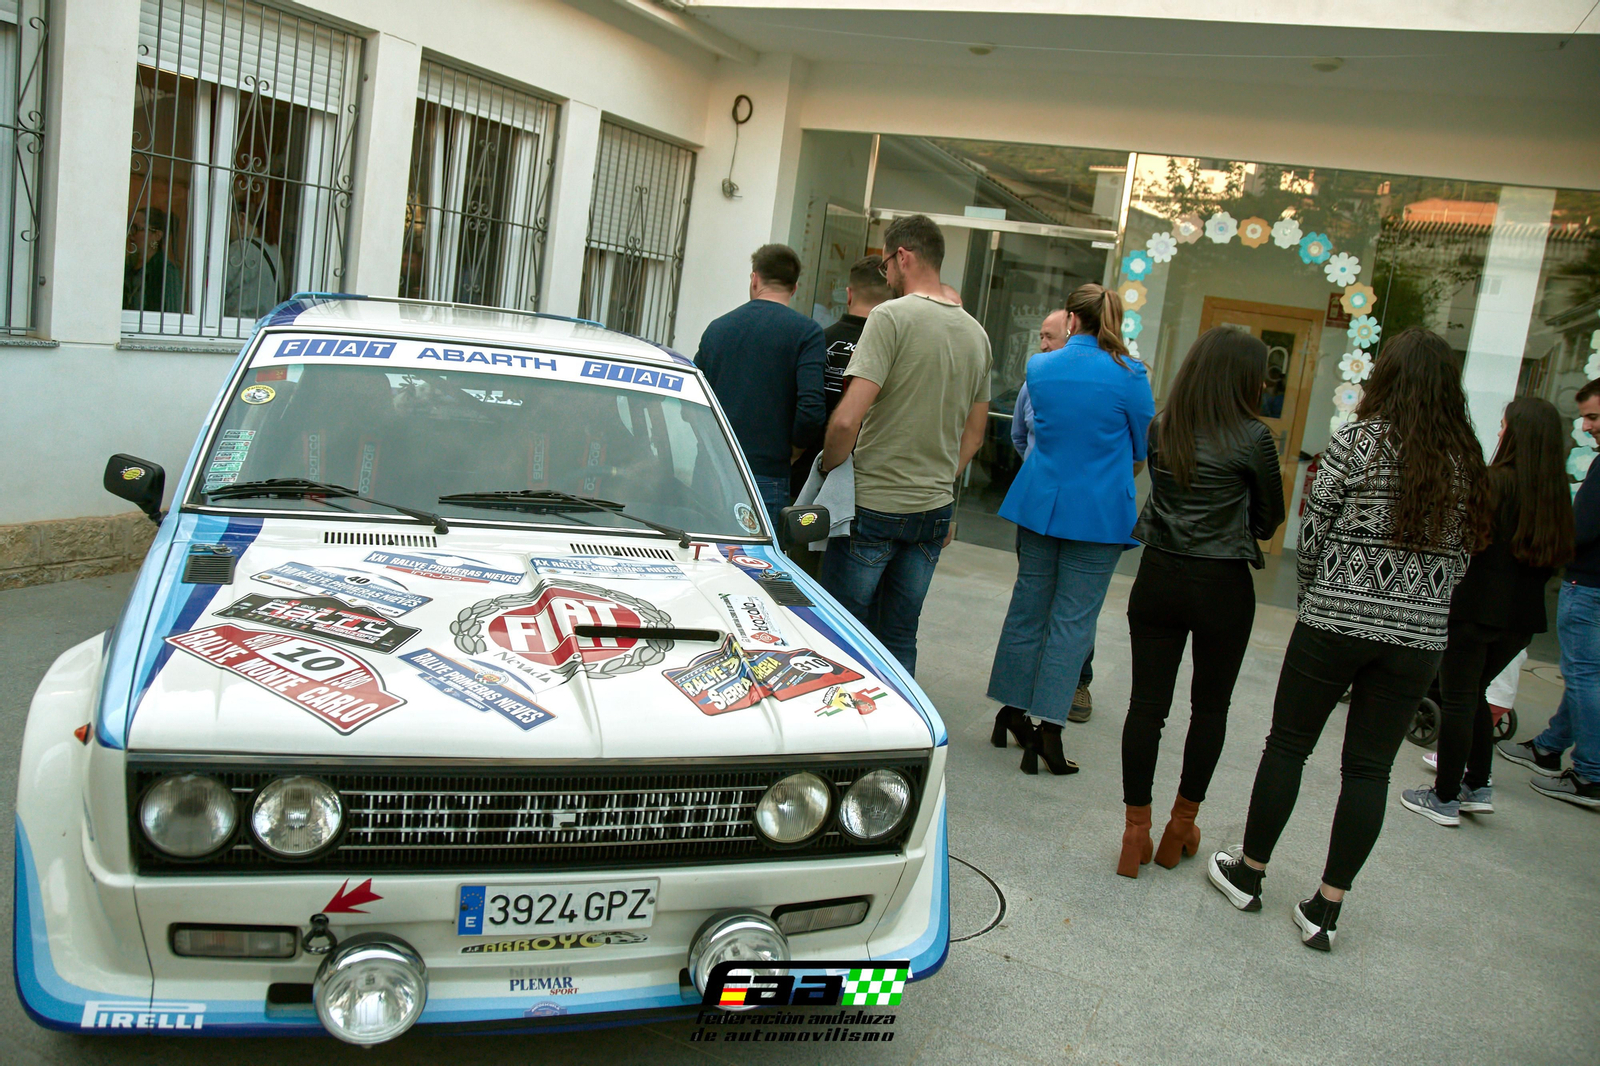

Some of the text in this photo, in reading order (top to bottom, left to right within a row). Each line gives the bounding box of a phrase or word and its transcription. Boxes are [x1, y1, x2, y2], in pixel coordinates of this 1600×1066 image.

[281, 341, 392, 356] FIAT
[416, 347, 557, 372] ABARTH
[588, 363, 680, 388] FIAT
[368, 552, 389, 562] XXI
[390, 556, 427, 569] RALLYE
[428, 563, 481, 577] PRIMERAS
[482, 572, 522, 584] NIEVES
[534, 559, 550, 567] XX
[551, 561, 588, 570] RALLYE
[591, 564, 644, 573] PRIMERAS
[347, 576, 370, 584] 40
[378, 593, 421, 608] NIEVES
[504, 598, 618, 653] FIAT
[272, 646, 345, 671] 10
[493, 651, 552, 684] Nevada
[794, 658, 829, 671] 310
[177, 630, 379, 723] RALLYE MONTE CARLO
[410, 652, 449, 676] RALLYE
[445, 670, 500, 701] PRIMERAS
[494, 696, 545, 724] NIEVES
[683, 666, 728, 697] RALLYE
[708, 677, 752, 710] SIERRA
[489, 888, 650, 925] 3924 GPZ
[465, 916, 476, 928] E
[509, 977, 573, 991] PLEMAR
[81, 1001, 206, 1029] PIRELLI
